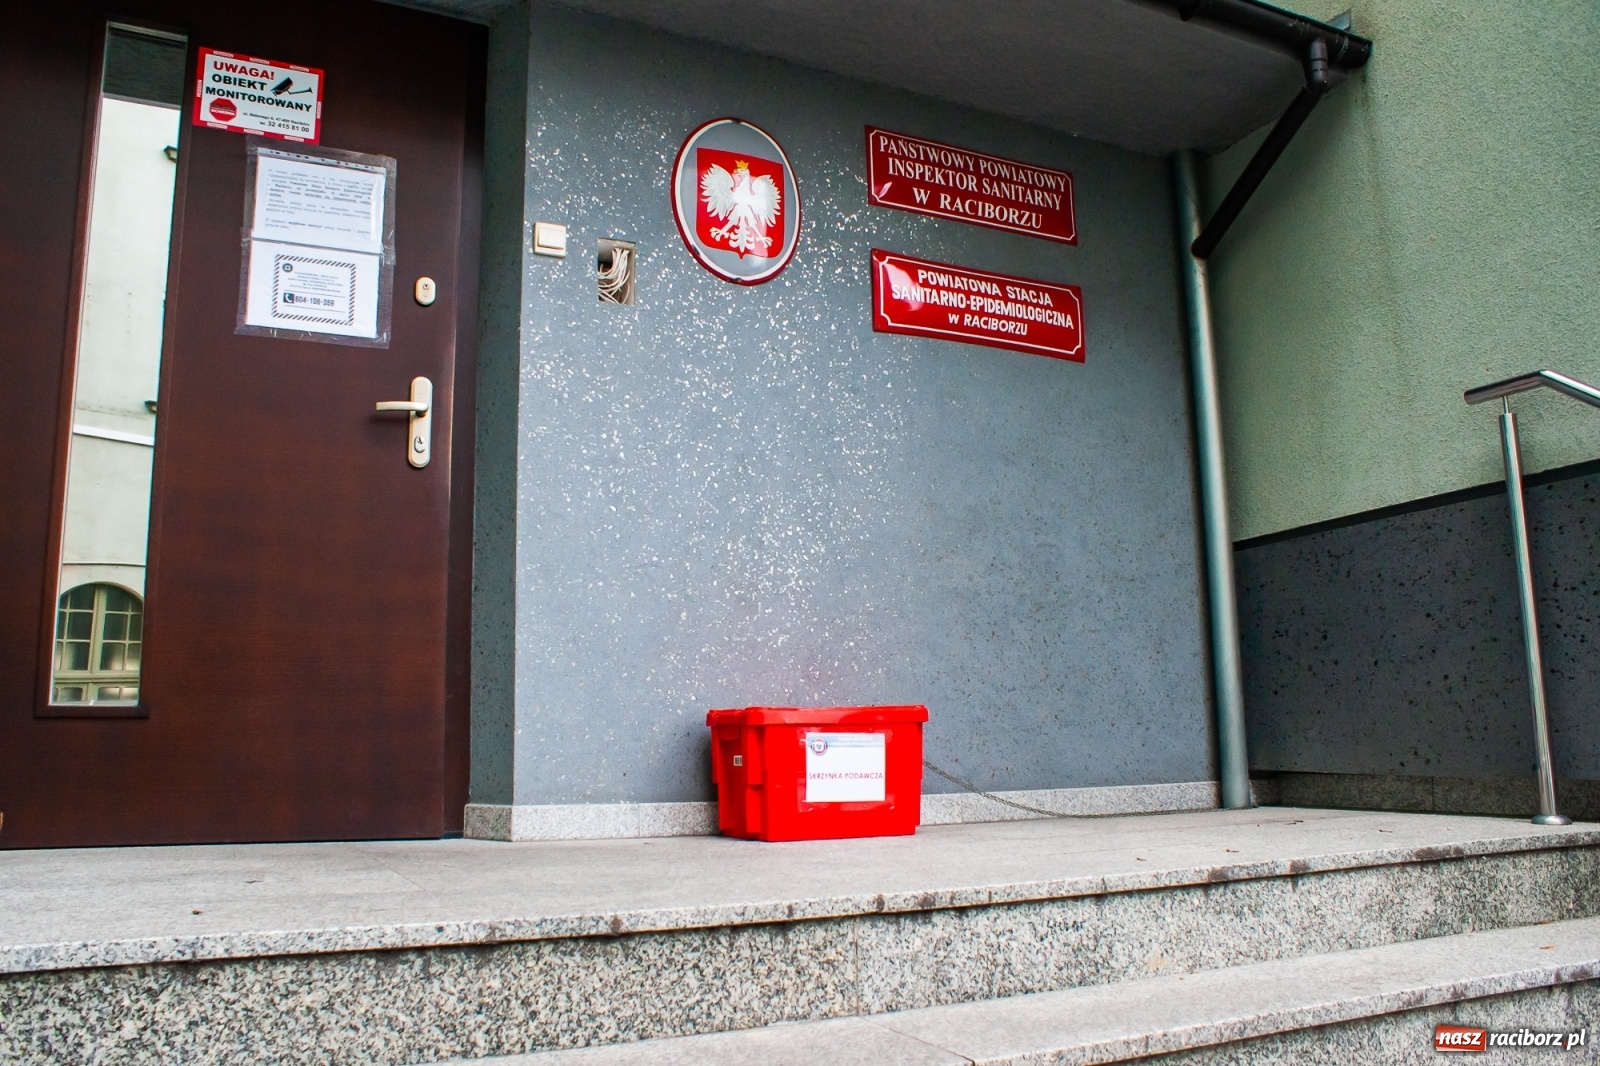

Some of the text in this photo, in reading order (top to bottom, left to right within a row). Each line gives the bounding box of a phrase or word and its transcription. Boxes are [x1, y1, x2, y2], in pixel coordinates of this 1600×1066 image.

[211, 73, 267, 91] OBIEKT
[213, 60, 275, 80] UWAGA!
[205, 86, 312, 112] MONITOROWANY
[879, 135, 1066, 193] PAŃSTWOWY POWIATOWY
[888, 157, 1062, 211] INSPEKTOR SANITARNY
[912, 187, 1043, 229] W RACIBORZU
[917, 269, 1053, 307] POWIATOWA STACJA
[891, 283, 1075, 330] SANITARNO-EPIDEMIOLOGICZNA
[963, 313, 1028, 336] RACIBORZU
[808, 772, 883, 780] SKRZYNKA PODAWCZA
